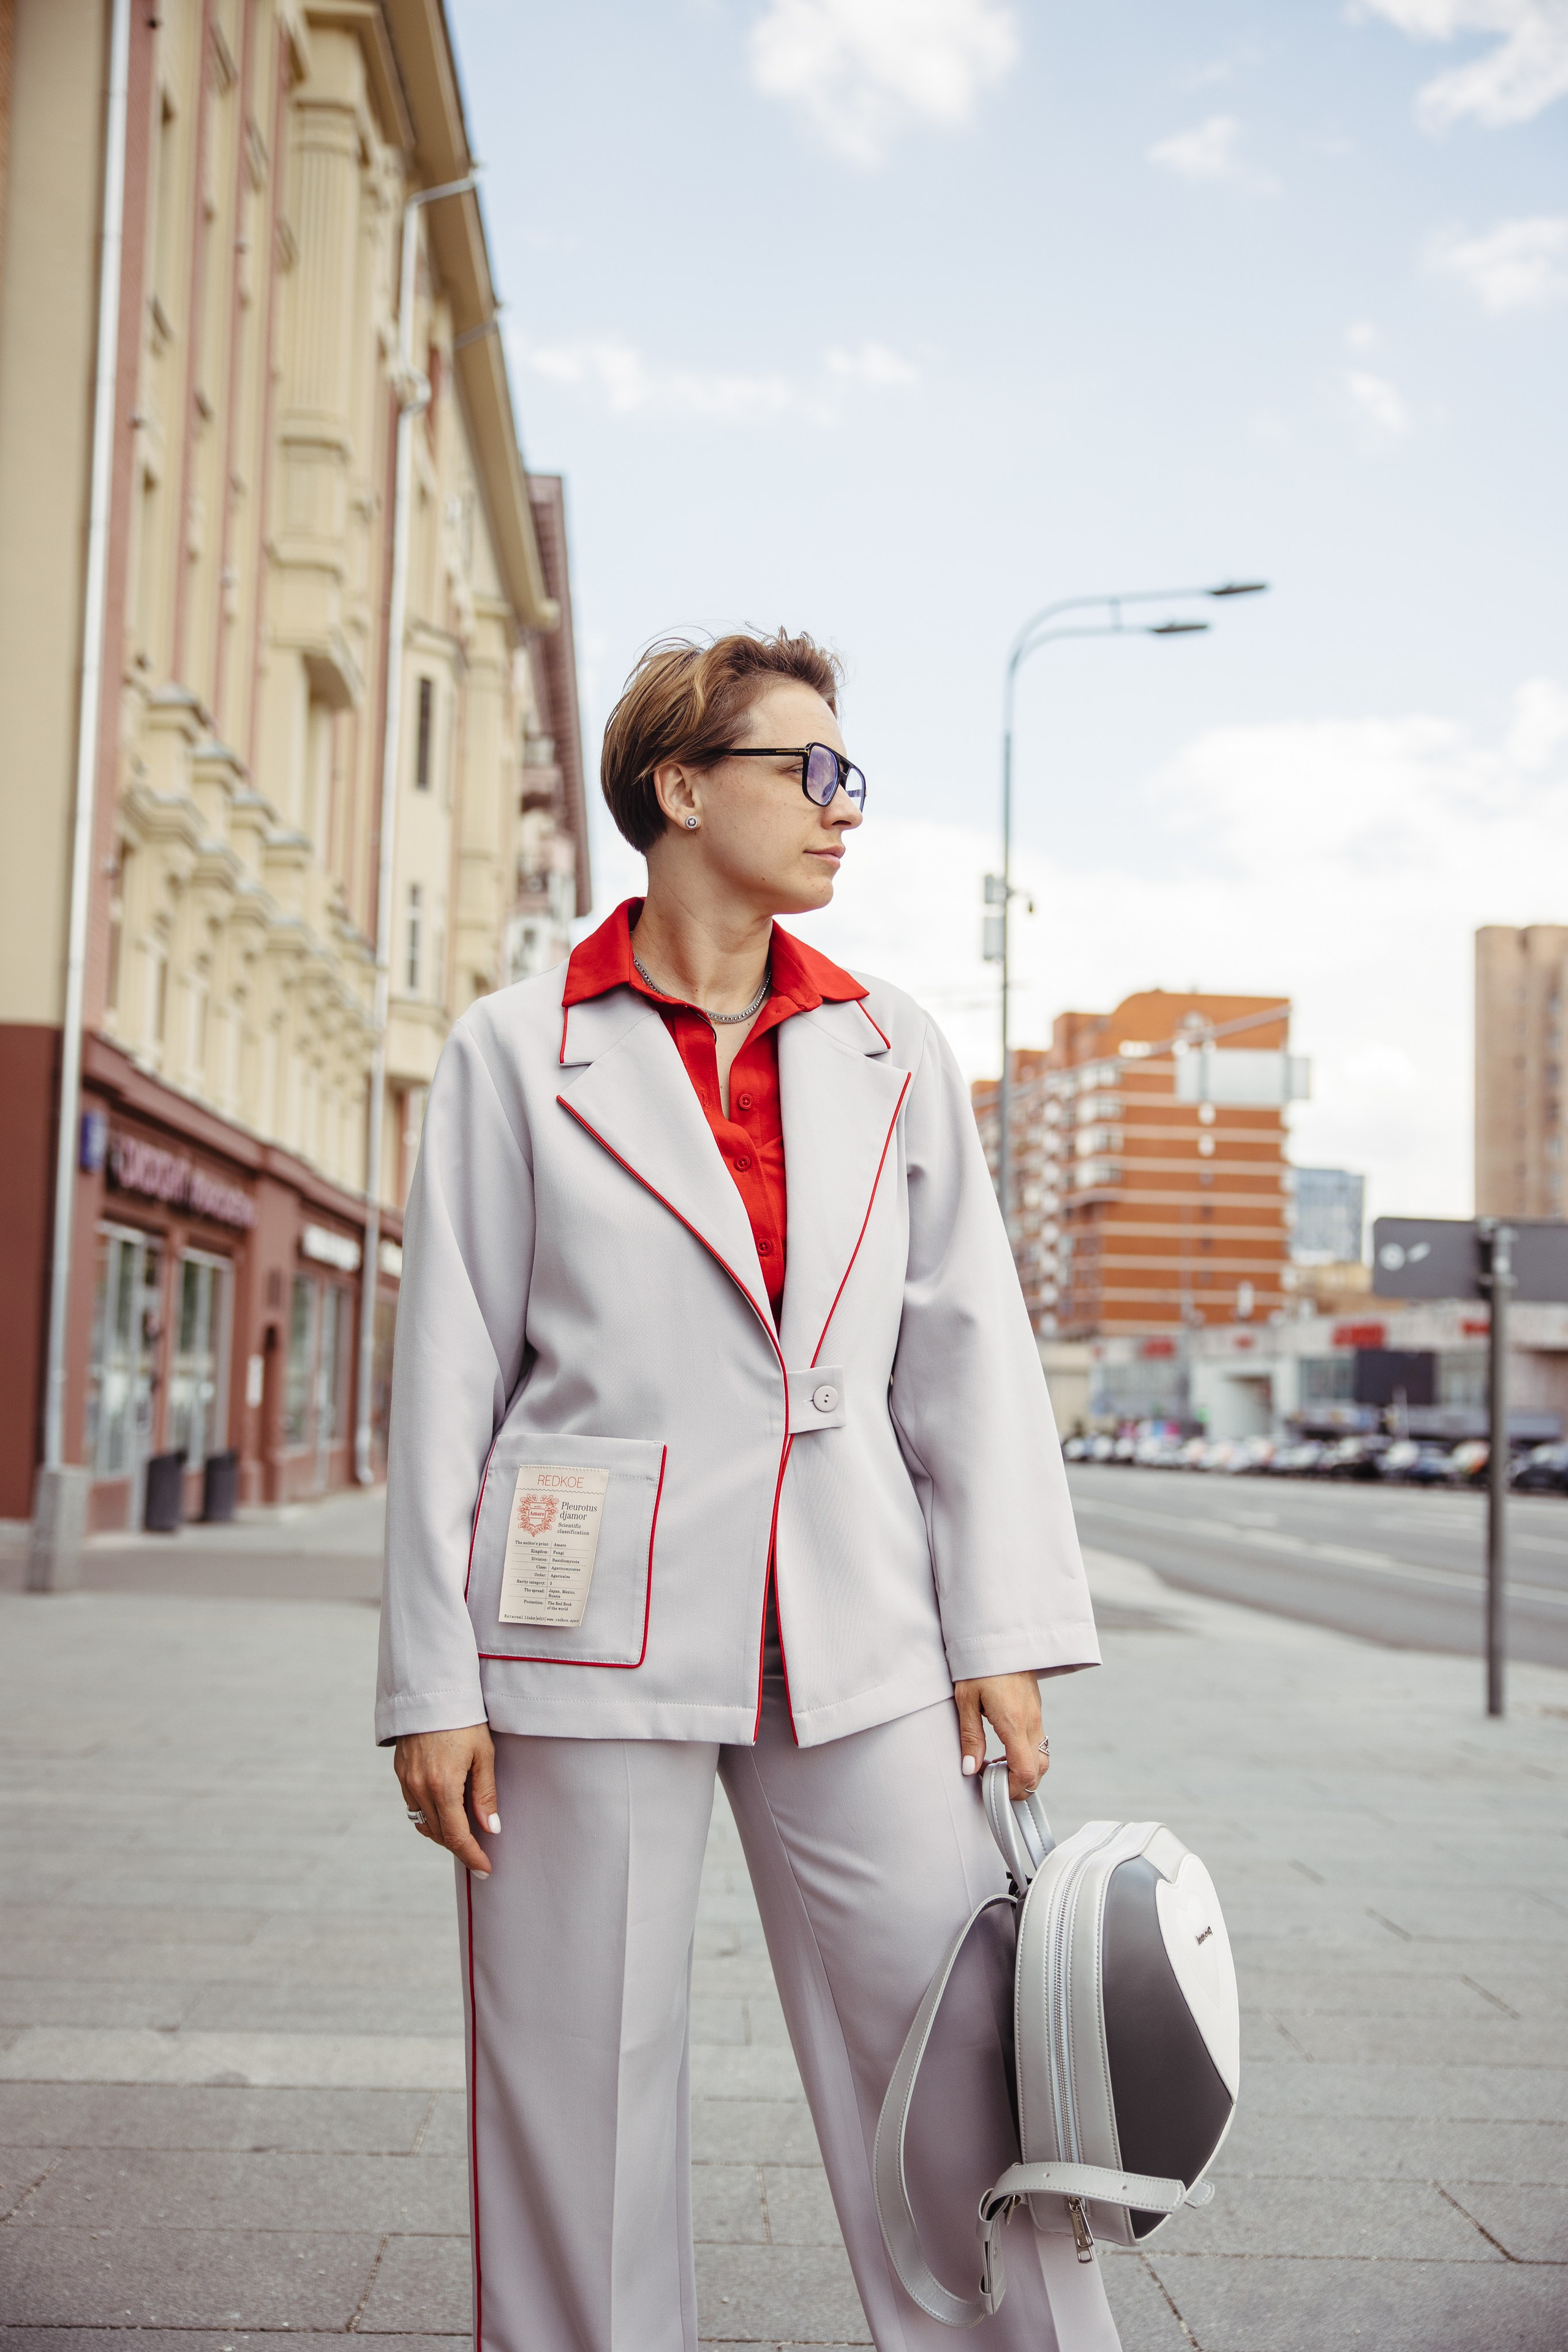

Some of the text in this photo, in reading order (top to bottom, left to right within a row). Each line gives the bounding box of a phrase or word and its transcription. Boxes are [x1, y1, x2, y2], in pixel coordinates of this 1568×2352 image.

[537, 1475, 584, 1488] REDKOE
[561, 1502, 597, 1512] Pleurotus
[560, 1511, 587, 1521] djamor
